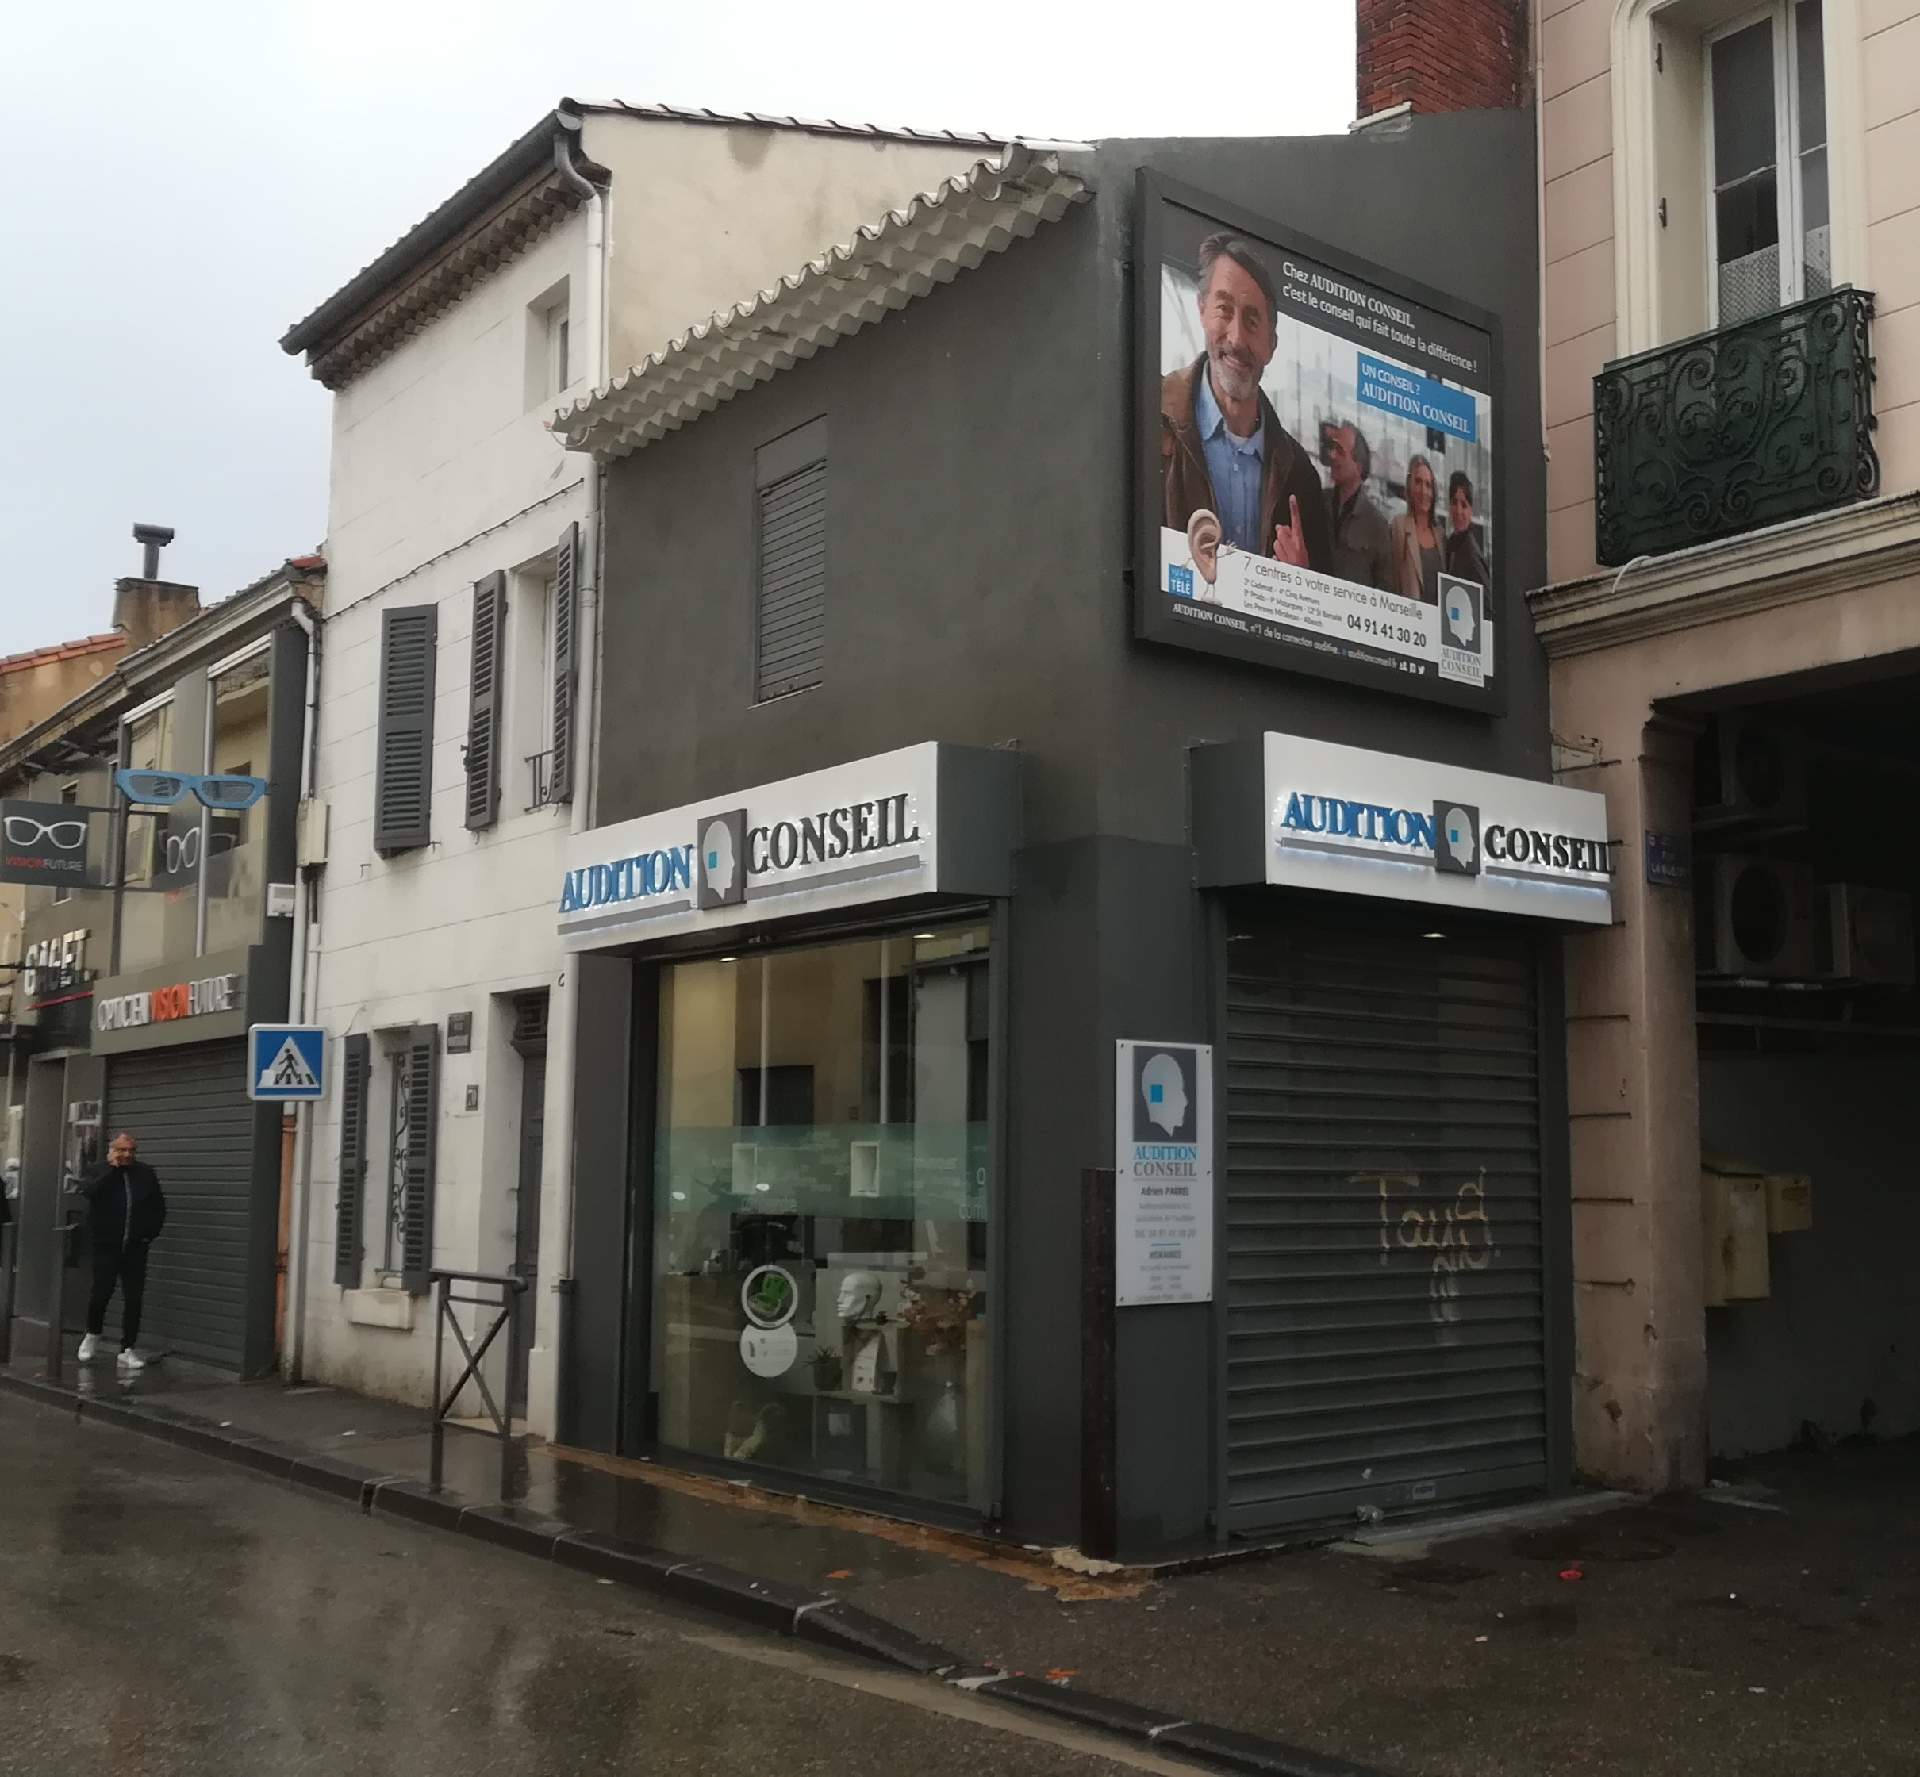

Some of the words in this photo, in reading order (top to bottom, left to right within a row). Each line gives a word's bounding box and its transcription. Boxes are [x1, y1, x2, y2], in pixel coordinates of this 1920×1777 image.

[1283, 261, 1309, 283] Chez
[1310, 274, 1366, 308] AUDITION
[1283, 283, 1306, 304] c'est
[1308, 292, 1318, 309] le
[1320, 300, 1354, 324] conseil
[1356, 315, 1371, 331] qui
[1373, 319, 1389, 337] fait
[1391, 328, 1416, 350] toute
[1418, 337, 1427, 352] la
[1361, 362, 1376, 379] UN
[1362, 381, 1420, 416] AUDITION
[1422, 404, 1471, 434] CONSEIL
[1244, 556, 1252, 571] 7
[1255, 564, 1292, 584] centres
[1305, 578, 1330, 594] votre
[1333, 586, 1367, 605] service
[1379, 595, 1423, 620] Marseille
[1172, 603, 1213, 623] AUDITION
[1347, 613, 1361, 632] 04
[1365, 618, 1378, 636] 91
[1380, 624, 1394, 640] 41
[1397, 628, 1411, 644] 30
[1413, 631, 1427, 648] 20
[1441, 647, 1481, 667] AUDITION
[1441, 659, 1481, 679] CONSEIL
[1280, 791, 1437, 850] AUDITION
[1484, 824, 1616, 875] CONSEIL
[558, 843, 694, 913] AUDITION
[746, 793, 921, 875] CONSEIL
[1133, 1162, 1197, 1177] CONSEIL
[1134, 1145, 1197, 1161] AUDITION
